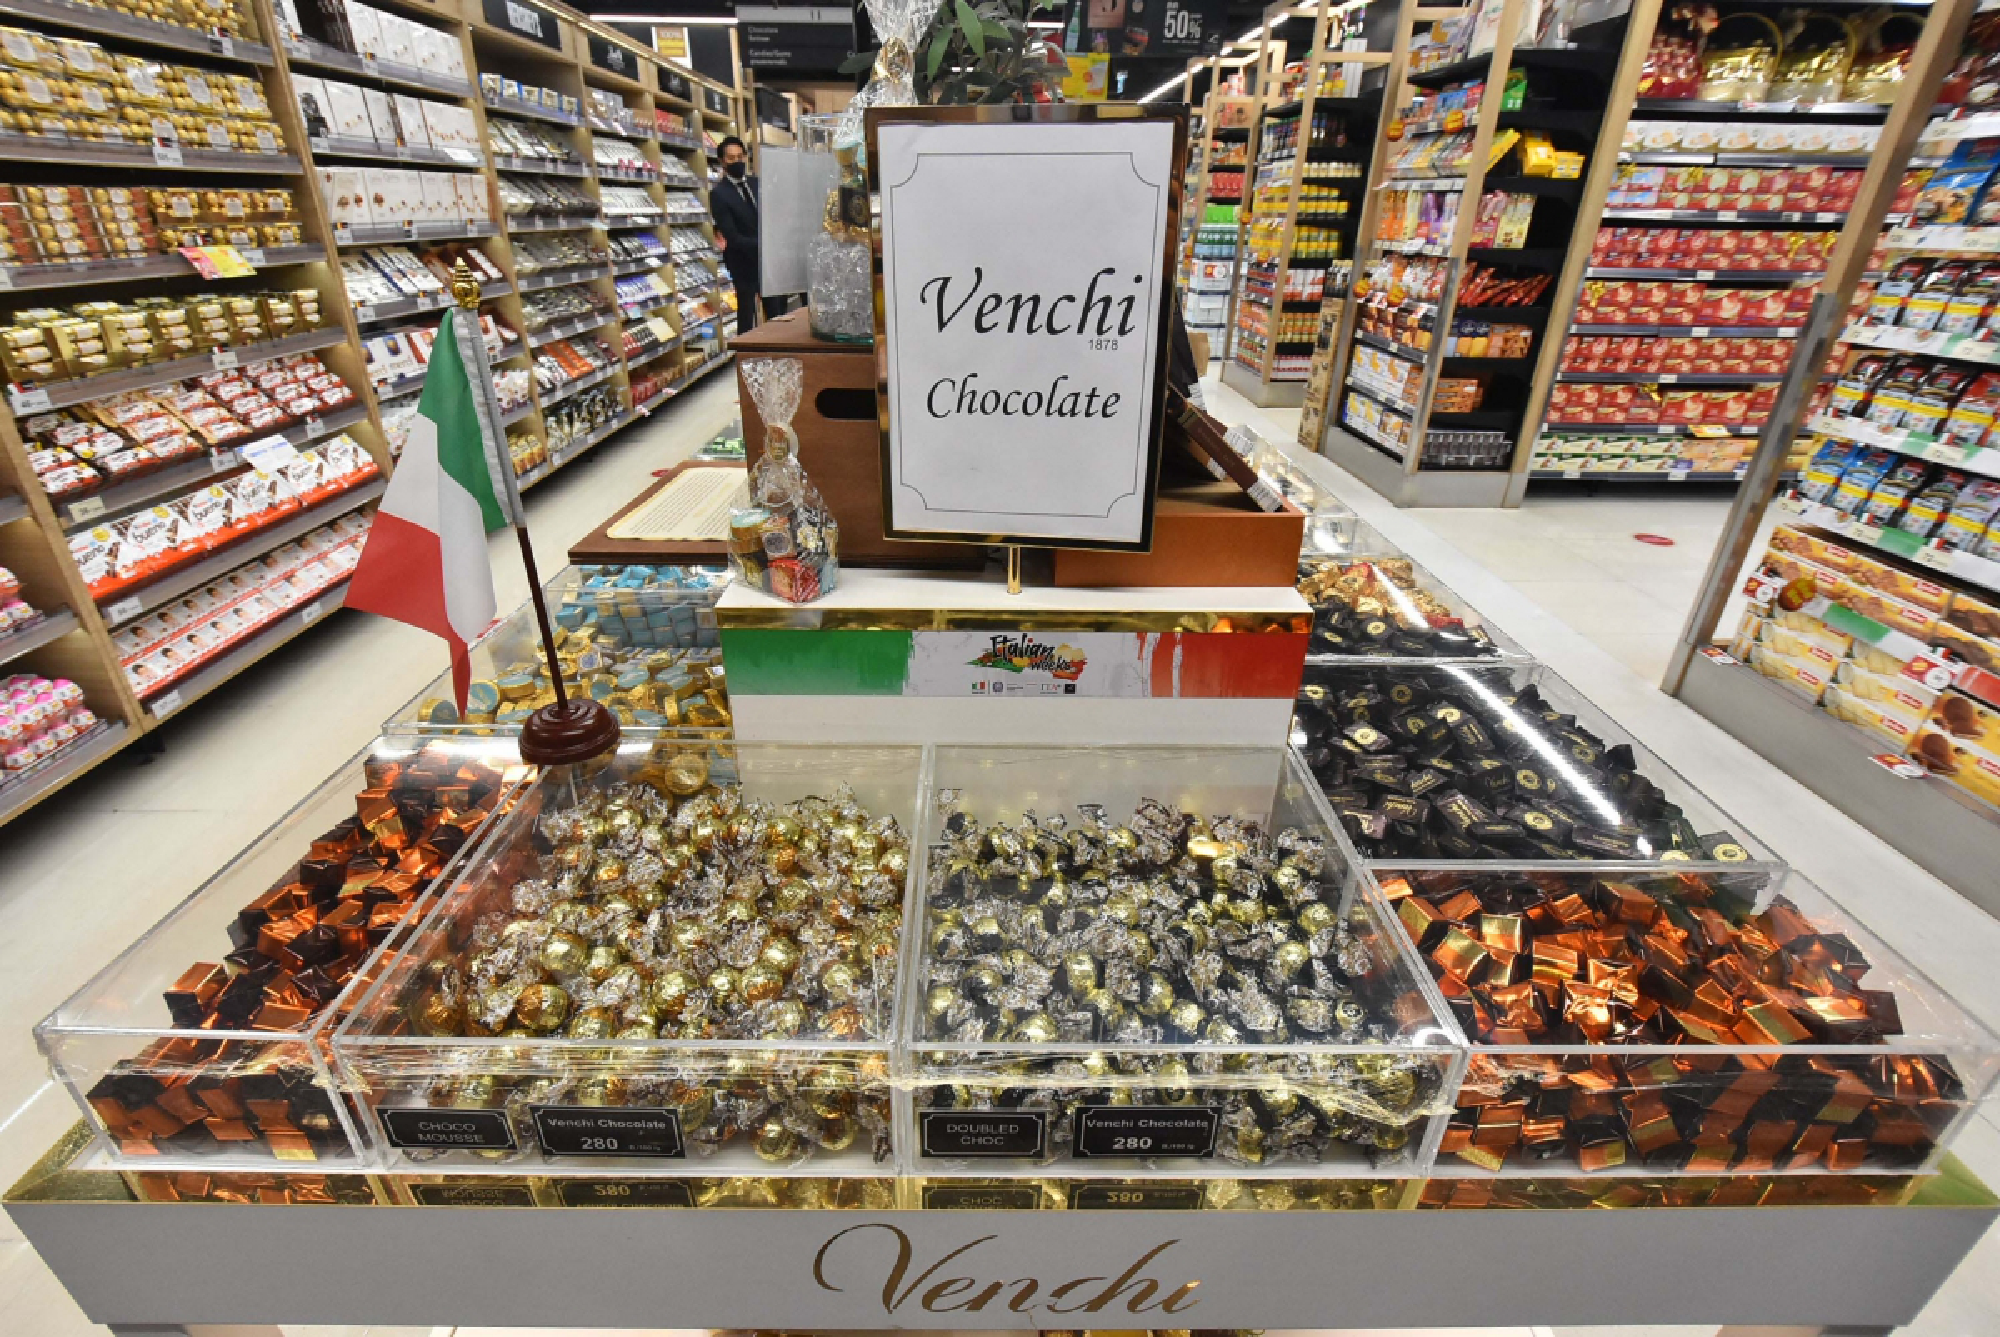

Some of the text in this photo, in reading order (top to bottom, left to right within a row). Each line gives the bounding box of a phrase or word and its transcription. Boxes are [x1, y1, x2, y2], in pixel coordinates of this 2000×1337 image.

[919, 266, 1143, 337] Venchi
[1087, 339, 1120, 351] 1878
[926, 372, 1121, 419] Chocolate
[418, 1121, 476, 1132] CHOCO
[547, 1117, 667, 1131] Venchi Chocolate
[946, 1122, 1020, 1134] DOUBLED
[1086, 1118, 1209, 1129] Venchi Chocolate
[417, 1132, 485, 1143] MOUSSE
[580, 1136, 619, 1151] 280
[959, 1135, 1005, 1146] CHOC
[1111, 1136, 1153, 1150] 280
[812, 1222, 1202, 1315] Venchi
